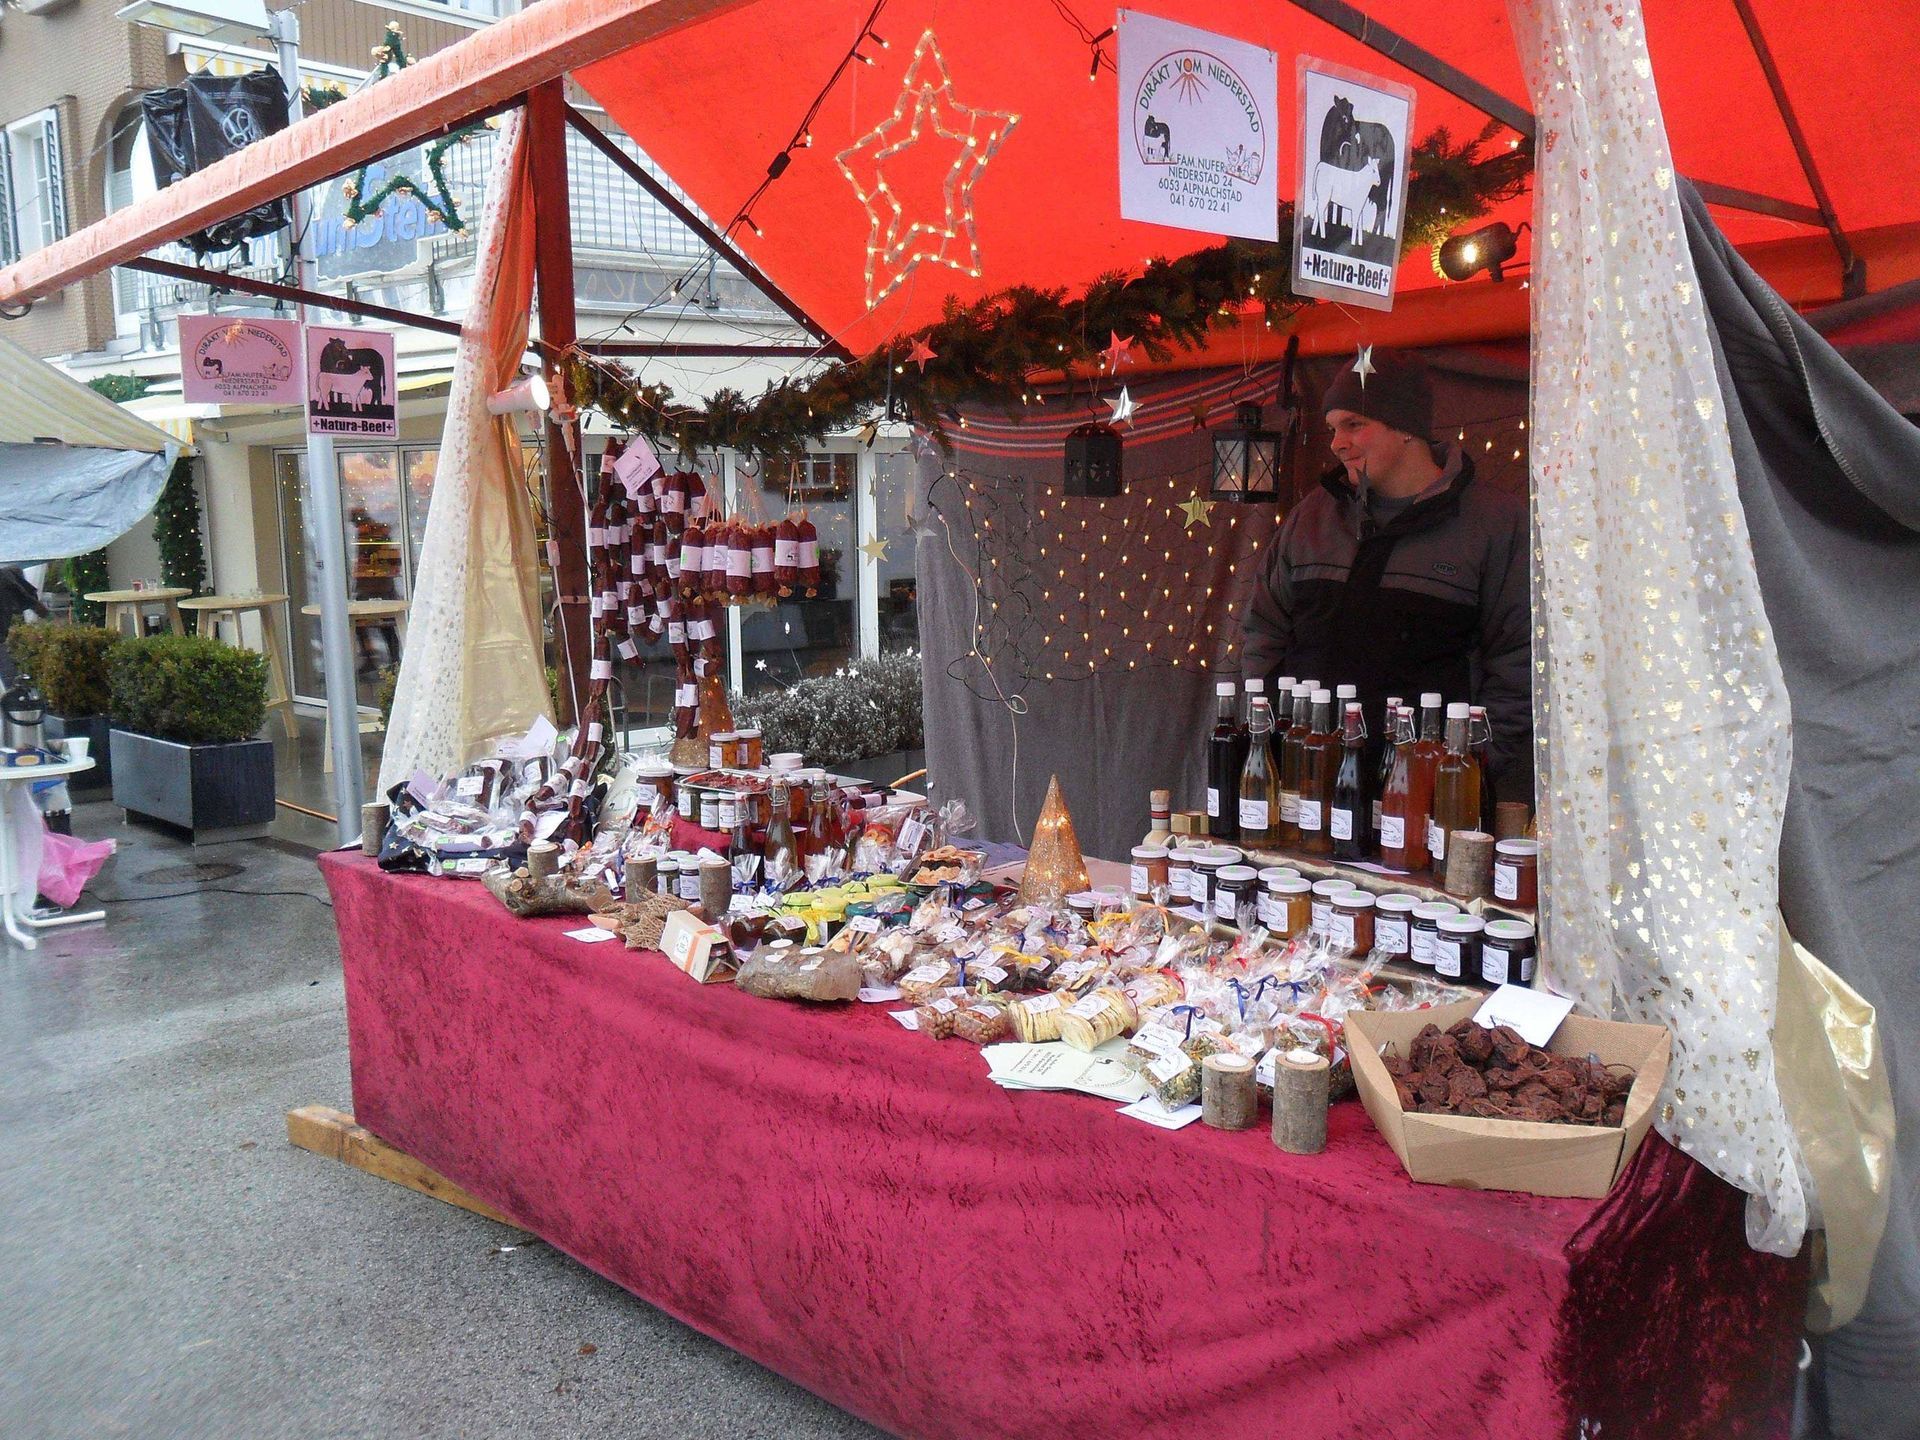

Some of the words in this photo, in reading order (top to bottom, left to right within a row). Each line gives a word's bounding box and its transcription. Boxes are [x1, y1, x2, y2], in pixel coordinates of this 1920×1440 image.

[1139, 63, 1170, 110] DIRÄKT
[1174, 57, 1202, 73] VOM
[1207, 61, 1260, 133] NIEDERSTAD
[1168, 166, 1220, 185] NIEDERSTAD
[1222, 175, 1233, 187] 24
[1158, 177, 1180, 192] 6053
[1182, 182, 1242, 202] ALPNACHSTAD
[1169, 193, 1185, 206] 041
[1188, 196, 1205, 209] 670
[1207, 199, 1218, 212] 22
[1220, 201, 1230, 213] 41
[247, 327, 288, 358] NIEDERSTAD
